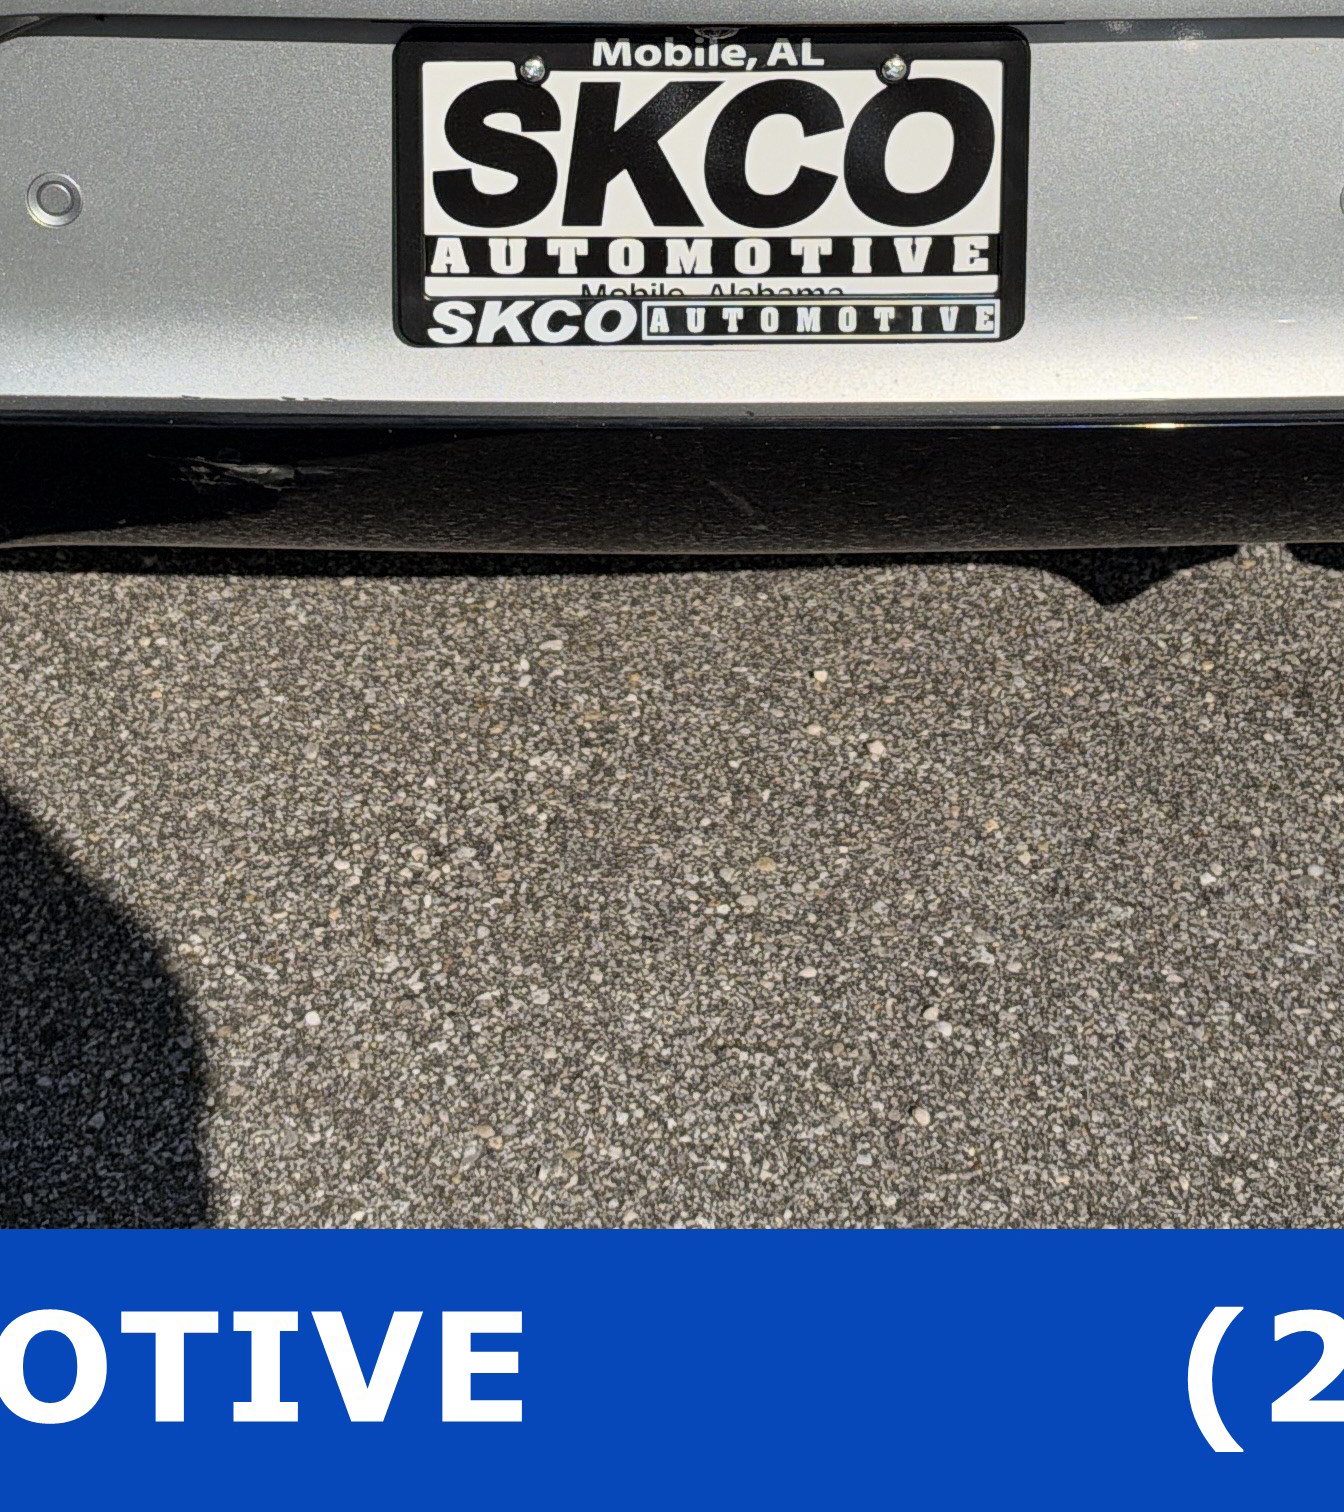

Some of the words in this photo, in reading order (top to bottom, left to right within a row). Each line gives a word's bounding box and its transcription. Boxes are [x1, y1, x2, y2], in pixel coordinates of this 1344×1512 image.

[592, 38, 757, 69] Mobile,
[767, 39, 825, 66] AL
[432, 79, 996, 229] SKCO
[430, 236, 990, 275] AUTOMOTIVE
[428, 300, 637, 344] SKCO
[650, 305, 995, 334] AUTOMOTIVE
